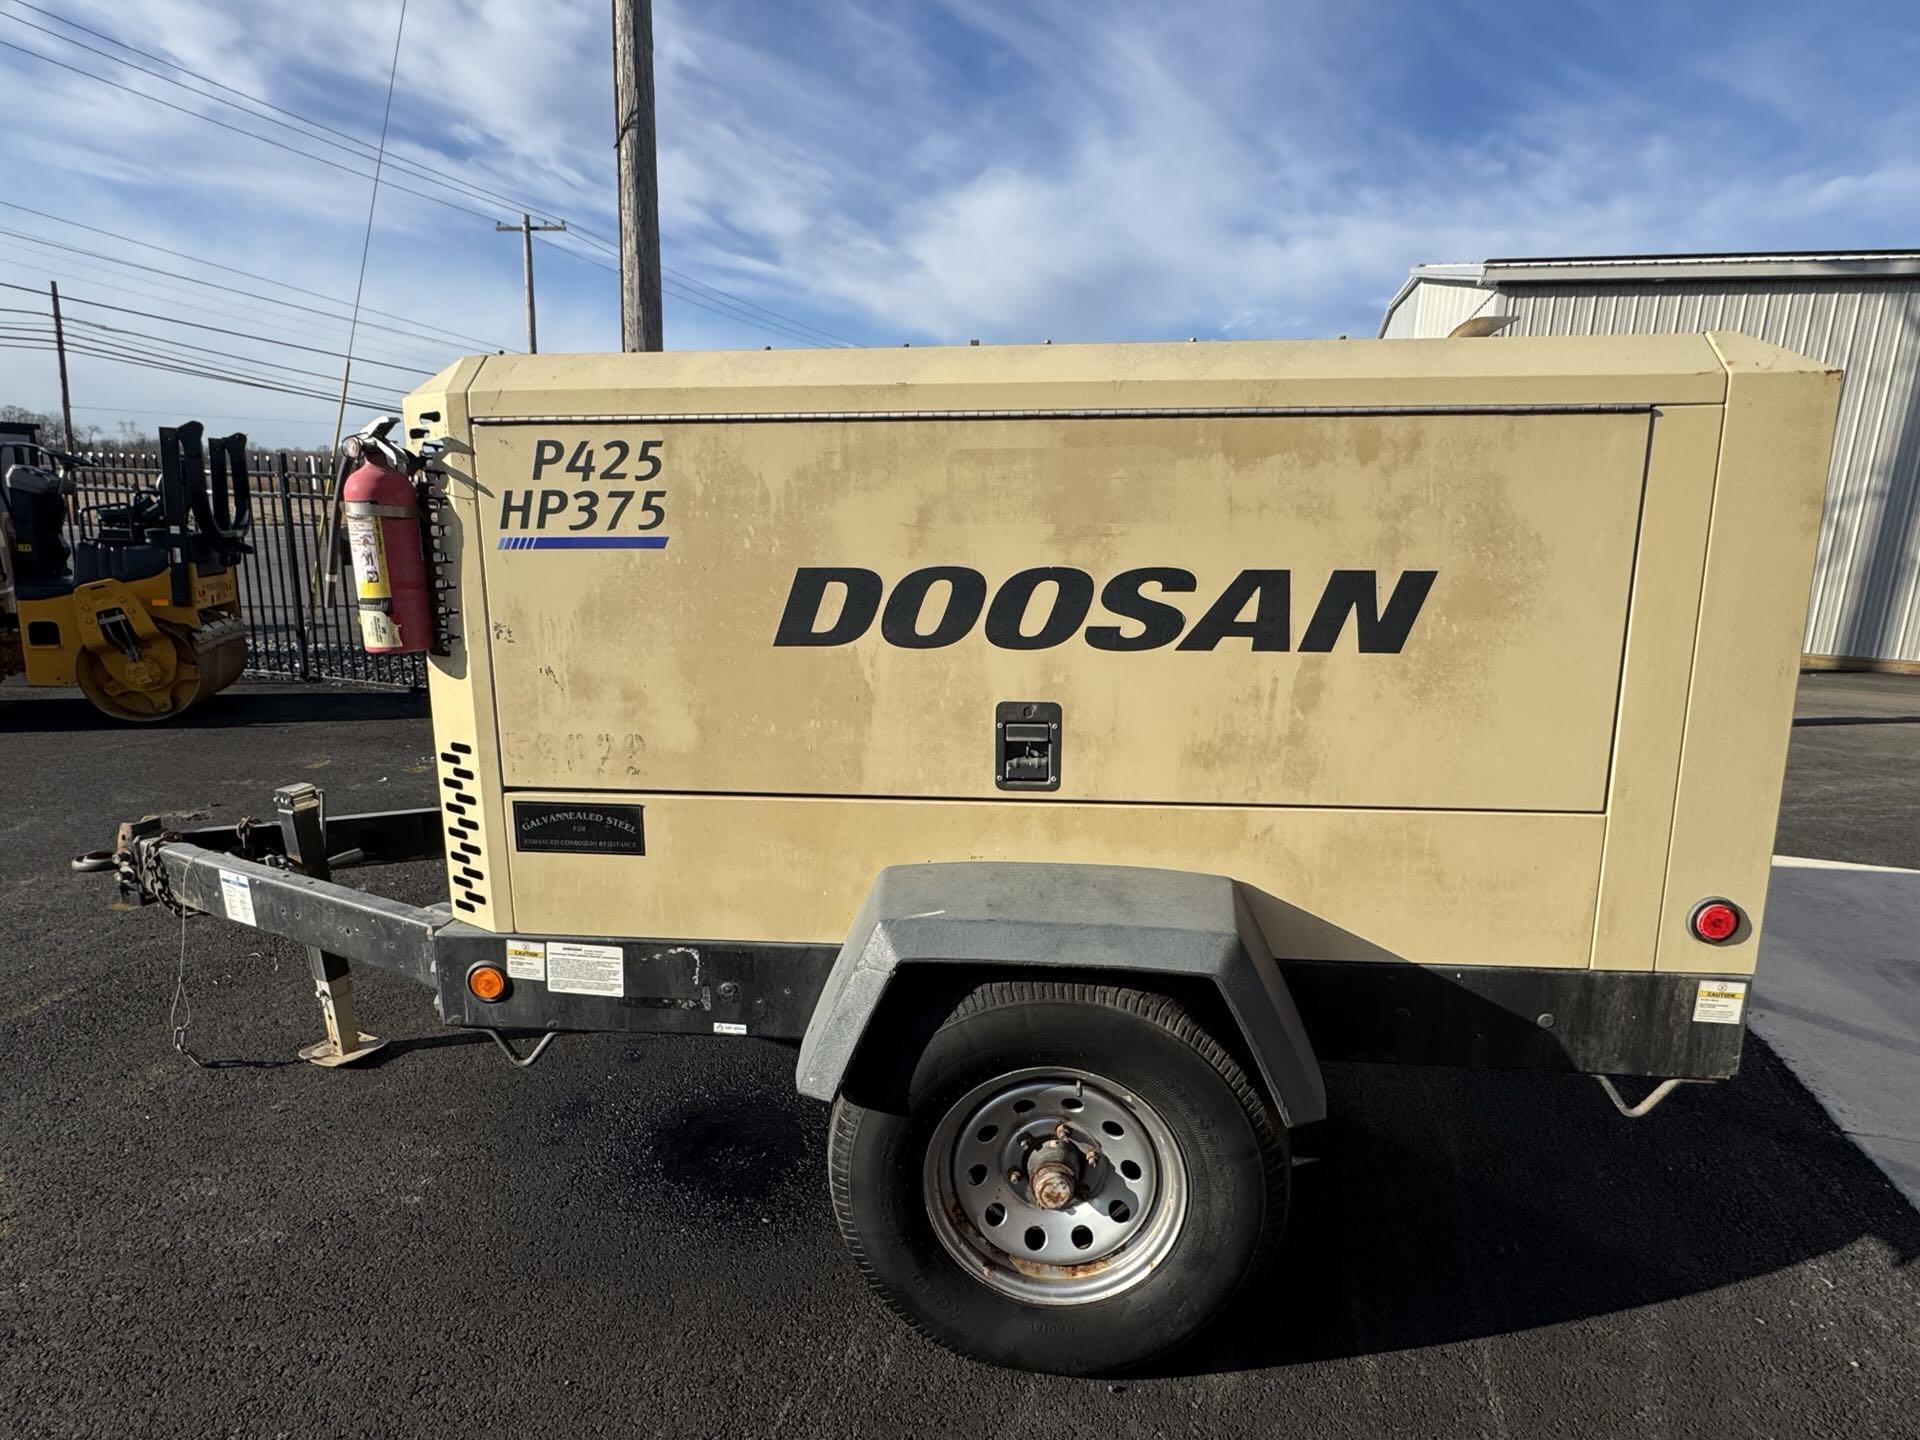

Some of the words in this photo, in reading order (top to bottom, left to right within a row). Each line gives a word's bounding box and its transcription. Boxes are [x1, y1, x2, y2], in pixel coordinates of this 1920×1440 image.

[532, 439, 665, 482] P425
[499, 489, 667, 531] HP375
[772, 565, 1438, 653] DOOSAN
[521, 811, 603, 831] GALVANNEALED
[606, 816, 637, 834] STEEL
